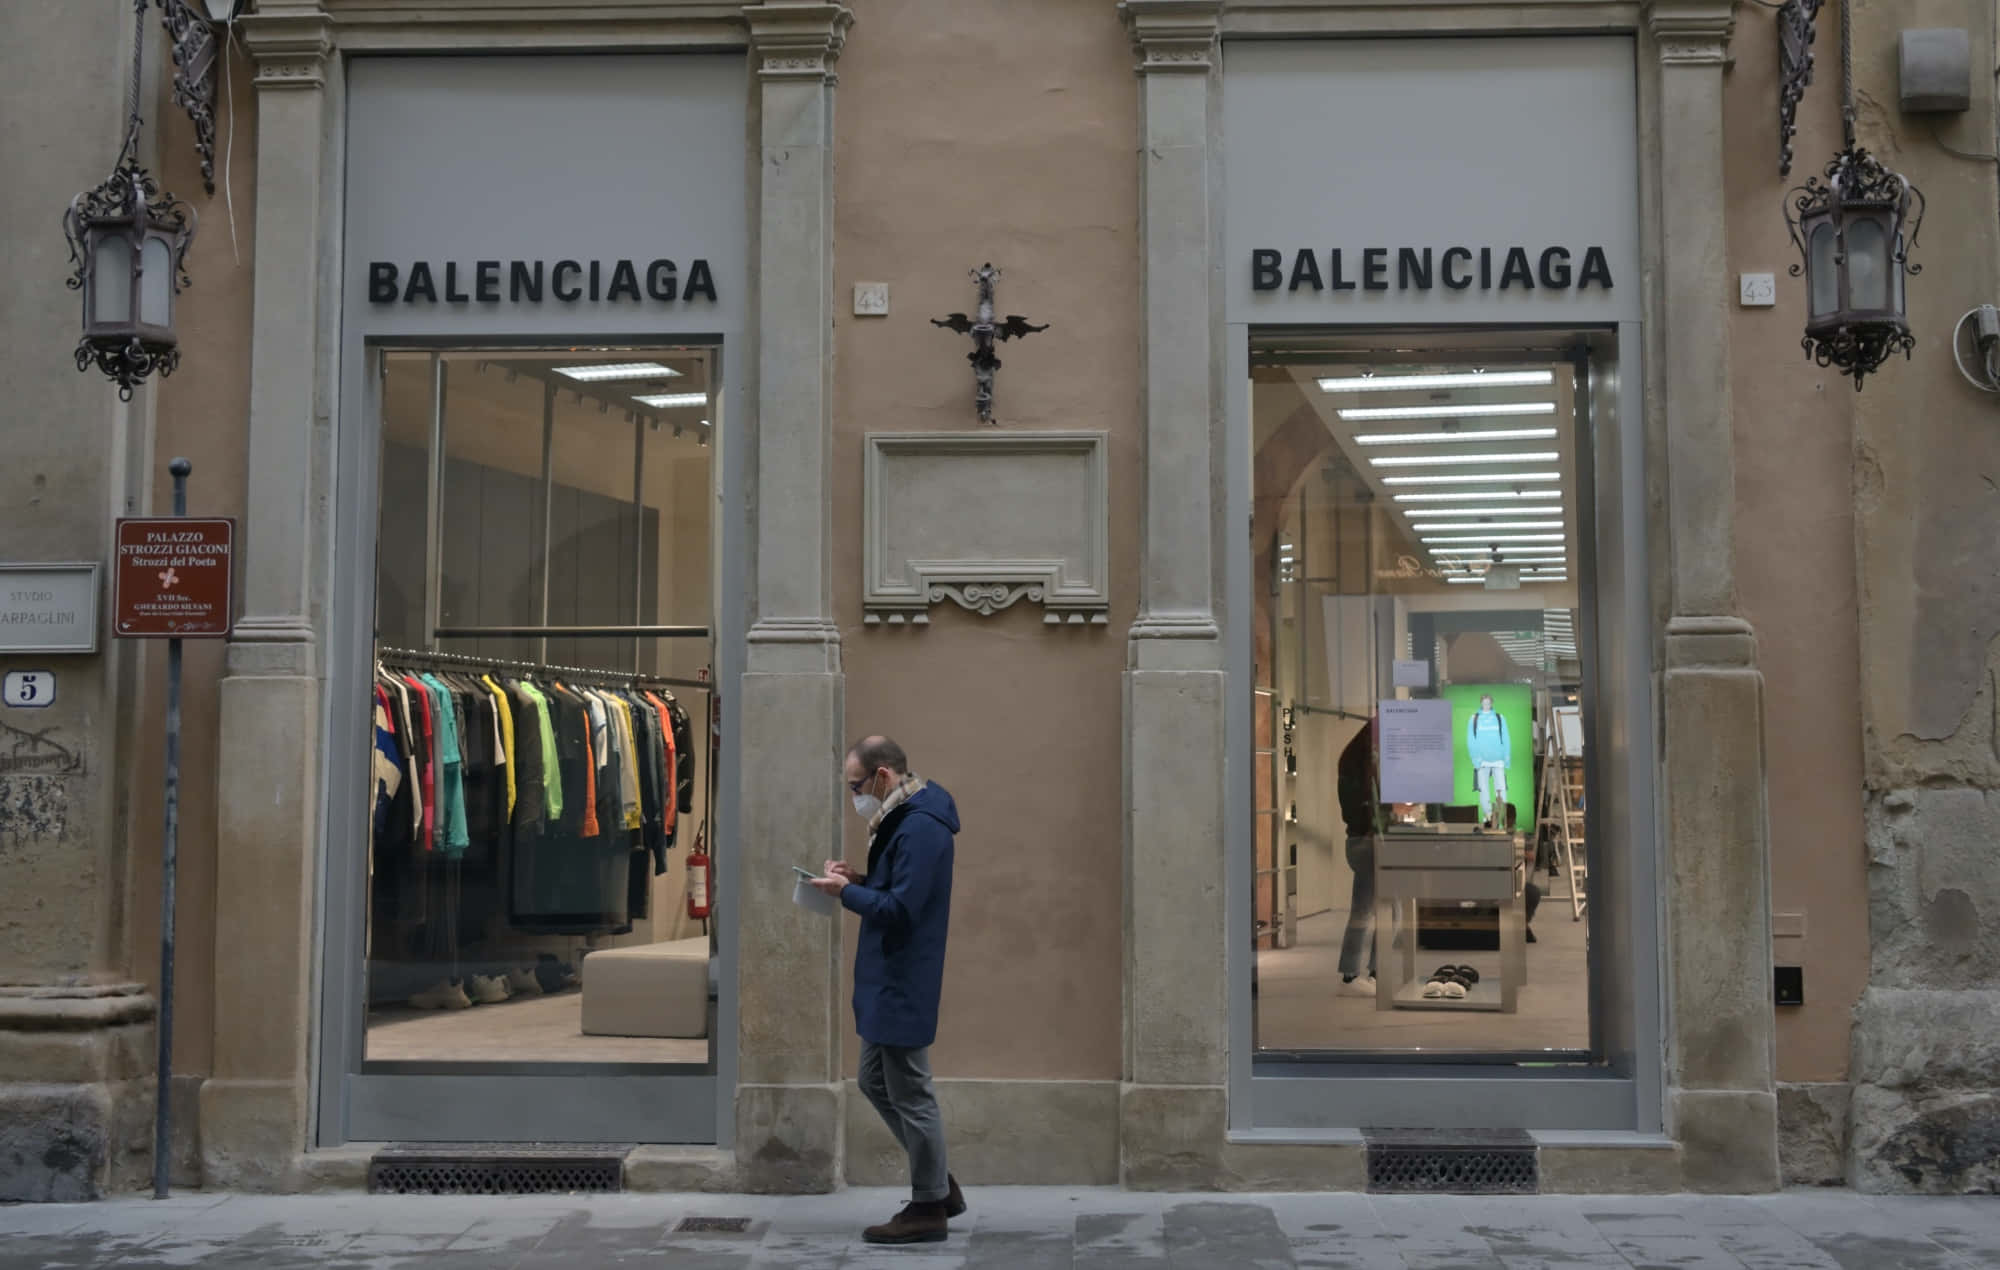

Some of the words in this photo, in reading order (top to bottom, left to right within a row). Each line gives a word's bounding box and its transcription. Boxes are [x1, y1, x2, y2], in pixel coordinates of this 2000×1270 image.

[1252, 246, 1614, 290] BALENCIAGA
[368, 259, 718, 302] BALENCIAGA
[146, 532, 204, 542] PALAZZO
[120, 544, 173, 554] STROZZI
[175, 544, 231, 554] GIACONI
[132, 557, 168, 566] Strozzi
[170, 556, 186, 566] del
[10, 591, 54, 601] STVDIO
[0, 611, 75, 625] ARPAGLINI
[20, 675, 37, 701] 5
[1282, 707, 1294, 757] PUSH
